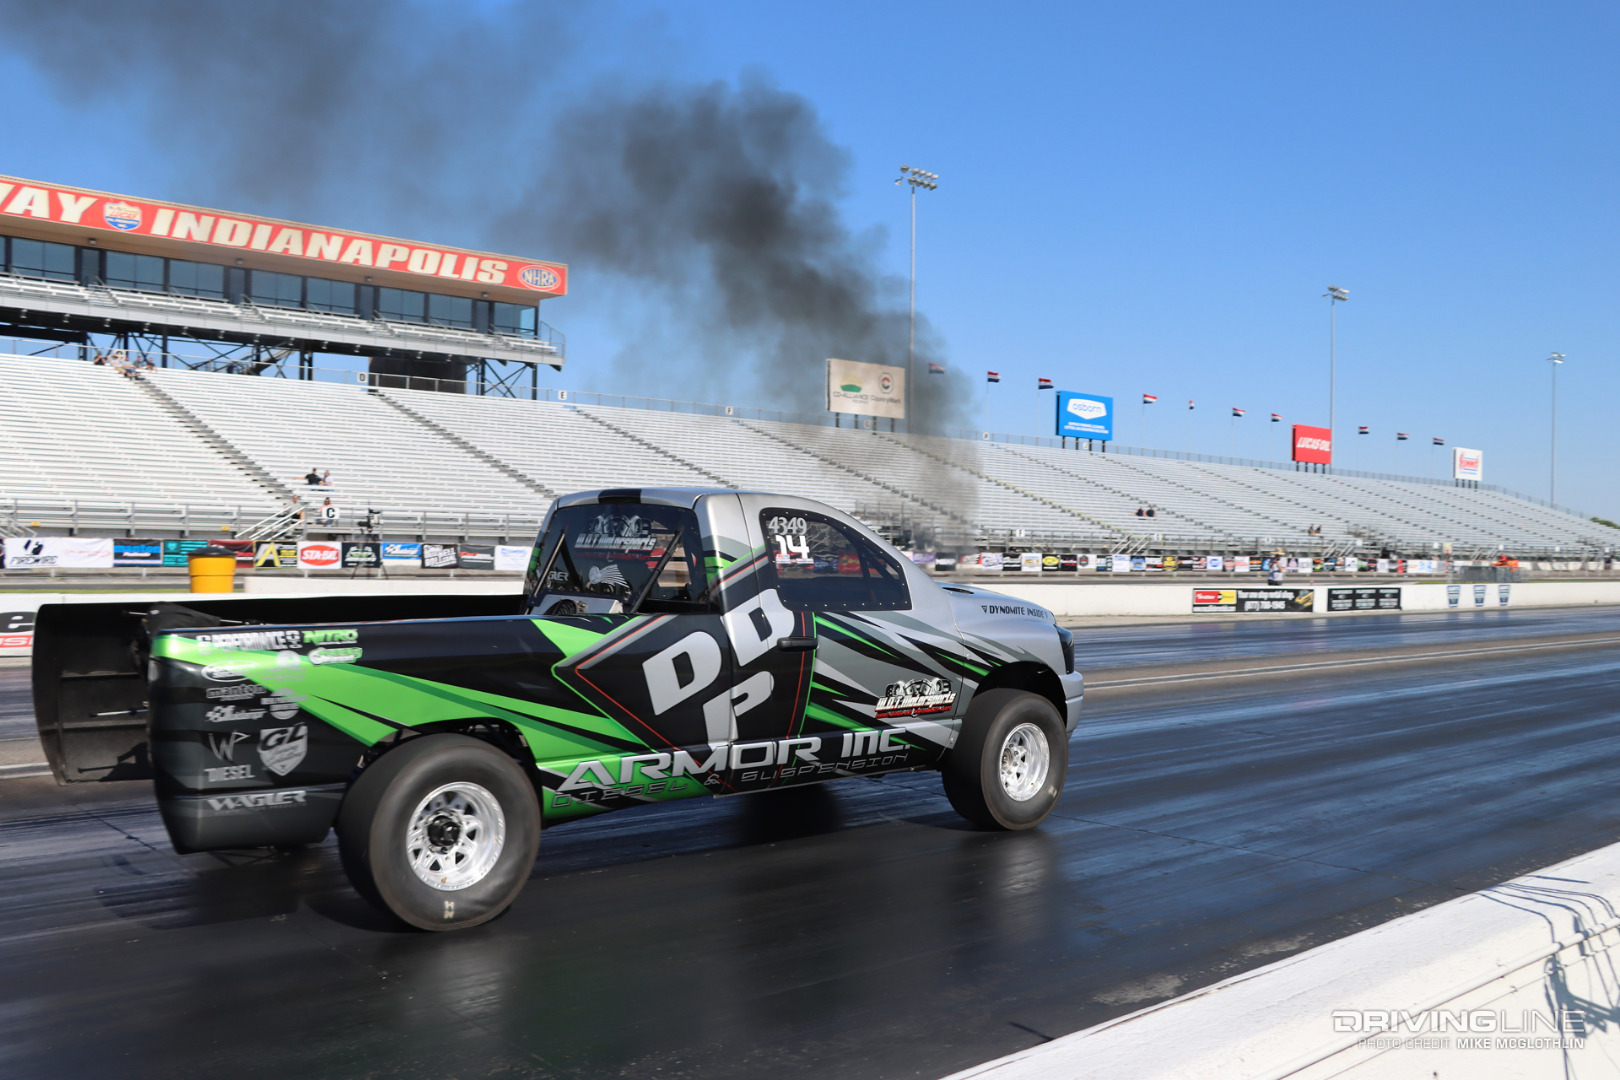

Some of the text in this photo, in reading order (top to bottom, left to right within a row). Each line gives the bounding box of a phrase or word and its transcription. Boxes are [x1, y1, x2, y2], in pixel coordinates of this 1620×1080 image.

[151, 208, 509, 284] INDIANAPOLIS
[523, 268, 556, 287] NHRA
[1296, 437, 1320, 450] LUCAS
[326, 507, 336, 519] C
[768, 516, 808, 536] 4349
[775, 535, 810, 559] 14
[989, 605, 1045, 618] DYNOMITE INSIDE
[301, 629, 358, 646] NITRO
[204, 765, 255, 782] DIESEL
[556, 736, 822, 792] ARMOR
[552, 779, 688, 808] DIESEL
[741, 753, 908, 782] SUSPENSION
[206, 790, 306, 811] WAGLER
